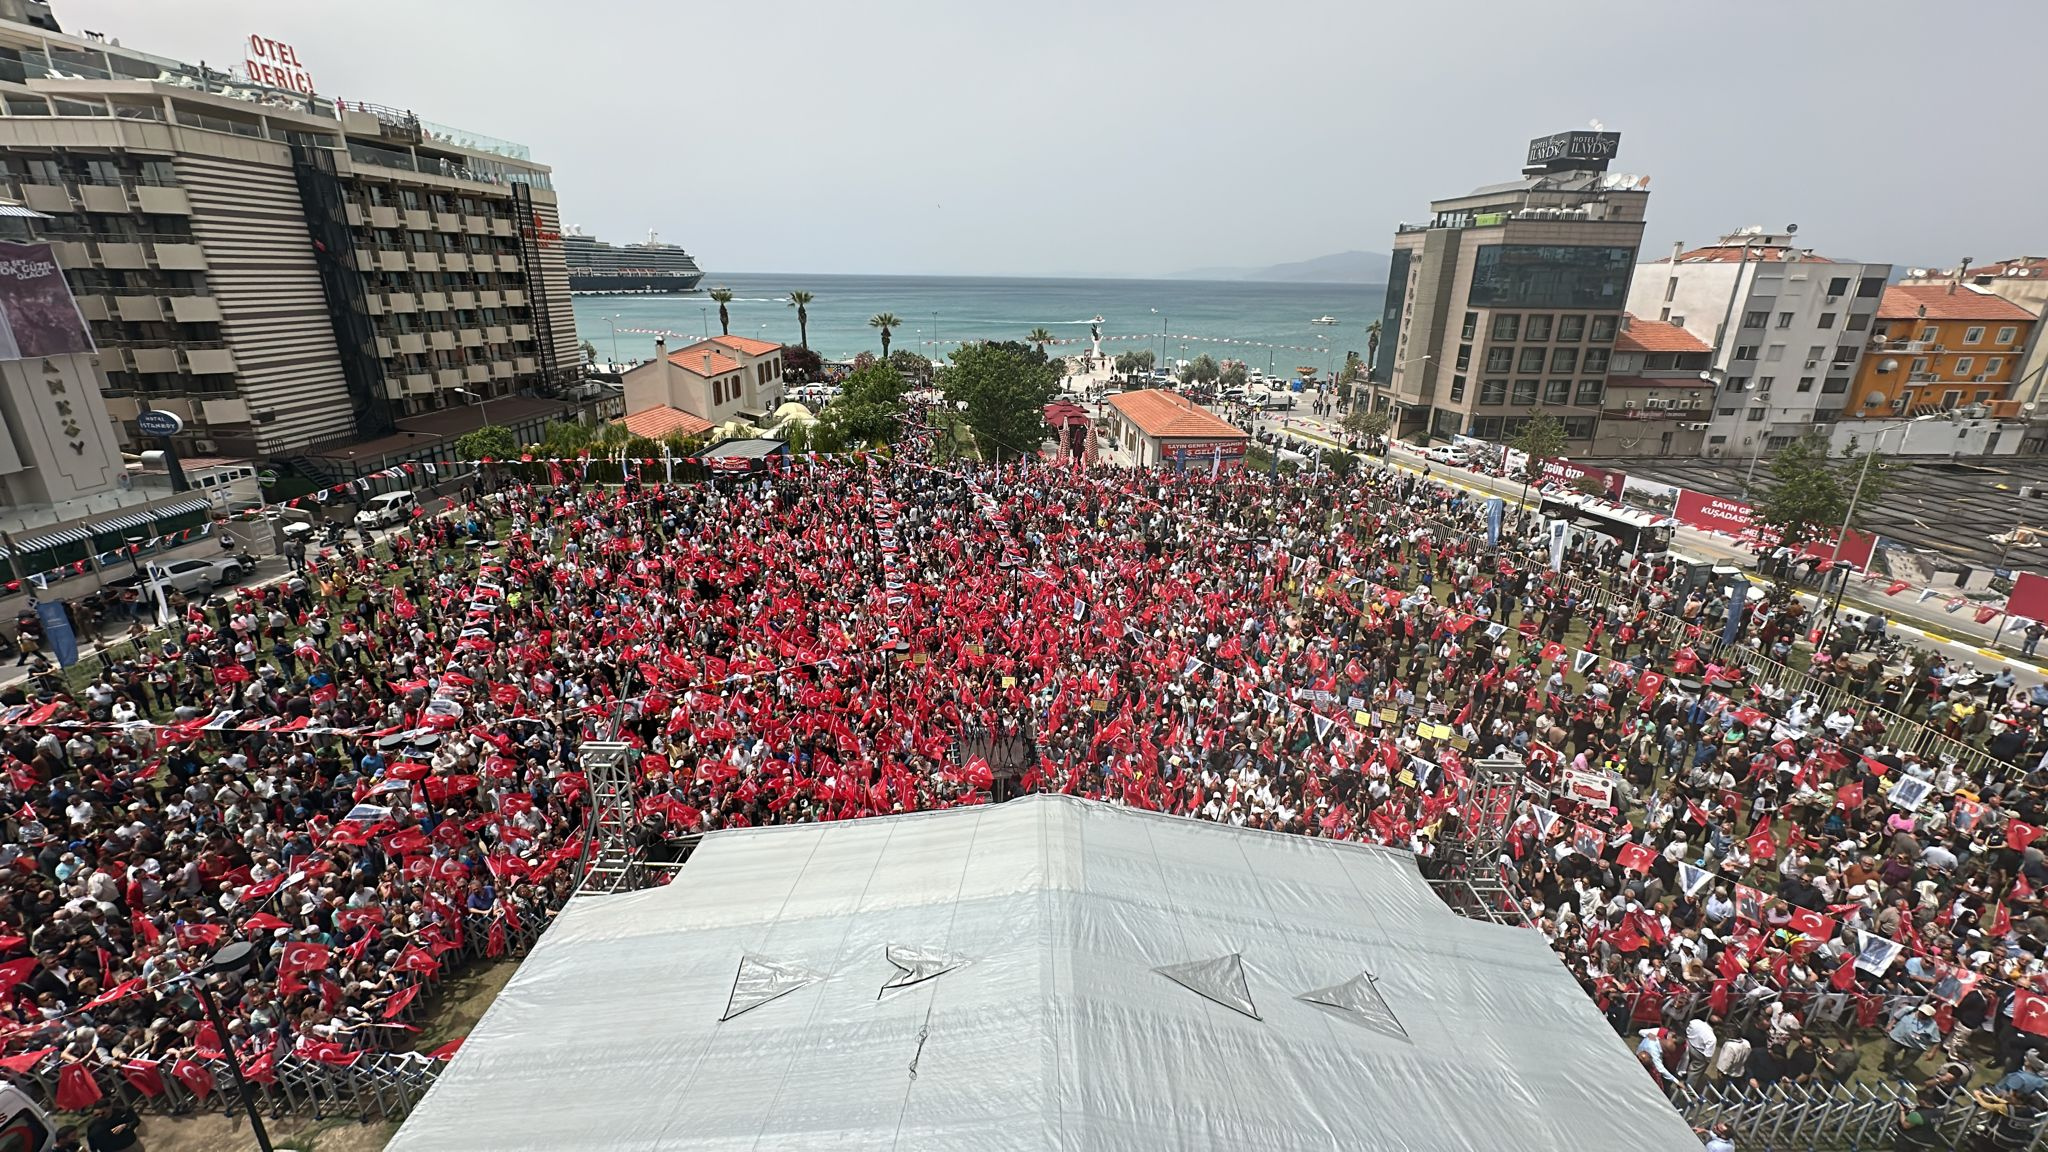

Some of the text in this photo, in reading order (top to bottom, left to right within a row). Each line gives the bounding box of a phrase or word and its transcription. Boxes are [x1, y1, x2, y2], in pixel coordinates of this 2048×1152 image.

[251, 33, 302, 68] OTEL
[247, 60, 315, 94] DERİCİ
[1532, 141, 1548, 149] HOTEL
[1711, 500, 1754, 515] SAYIN GE
